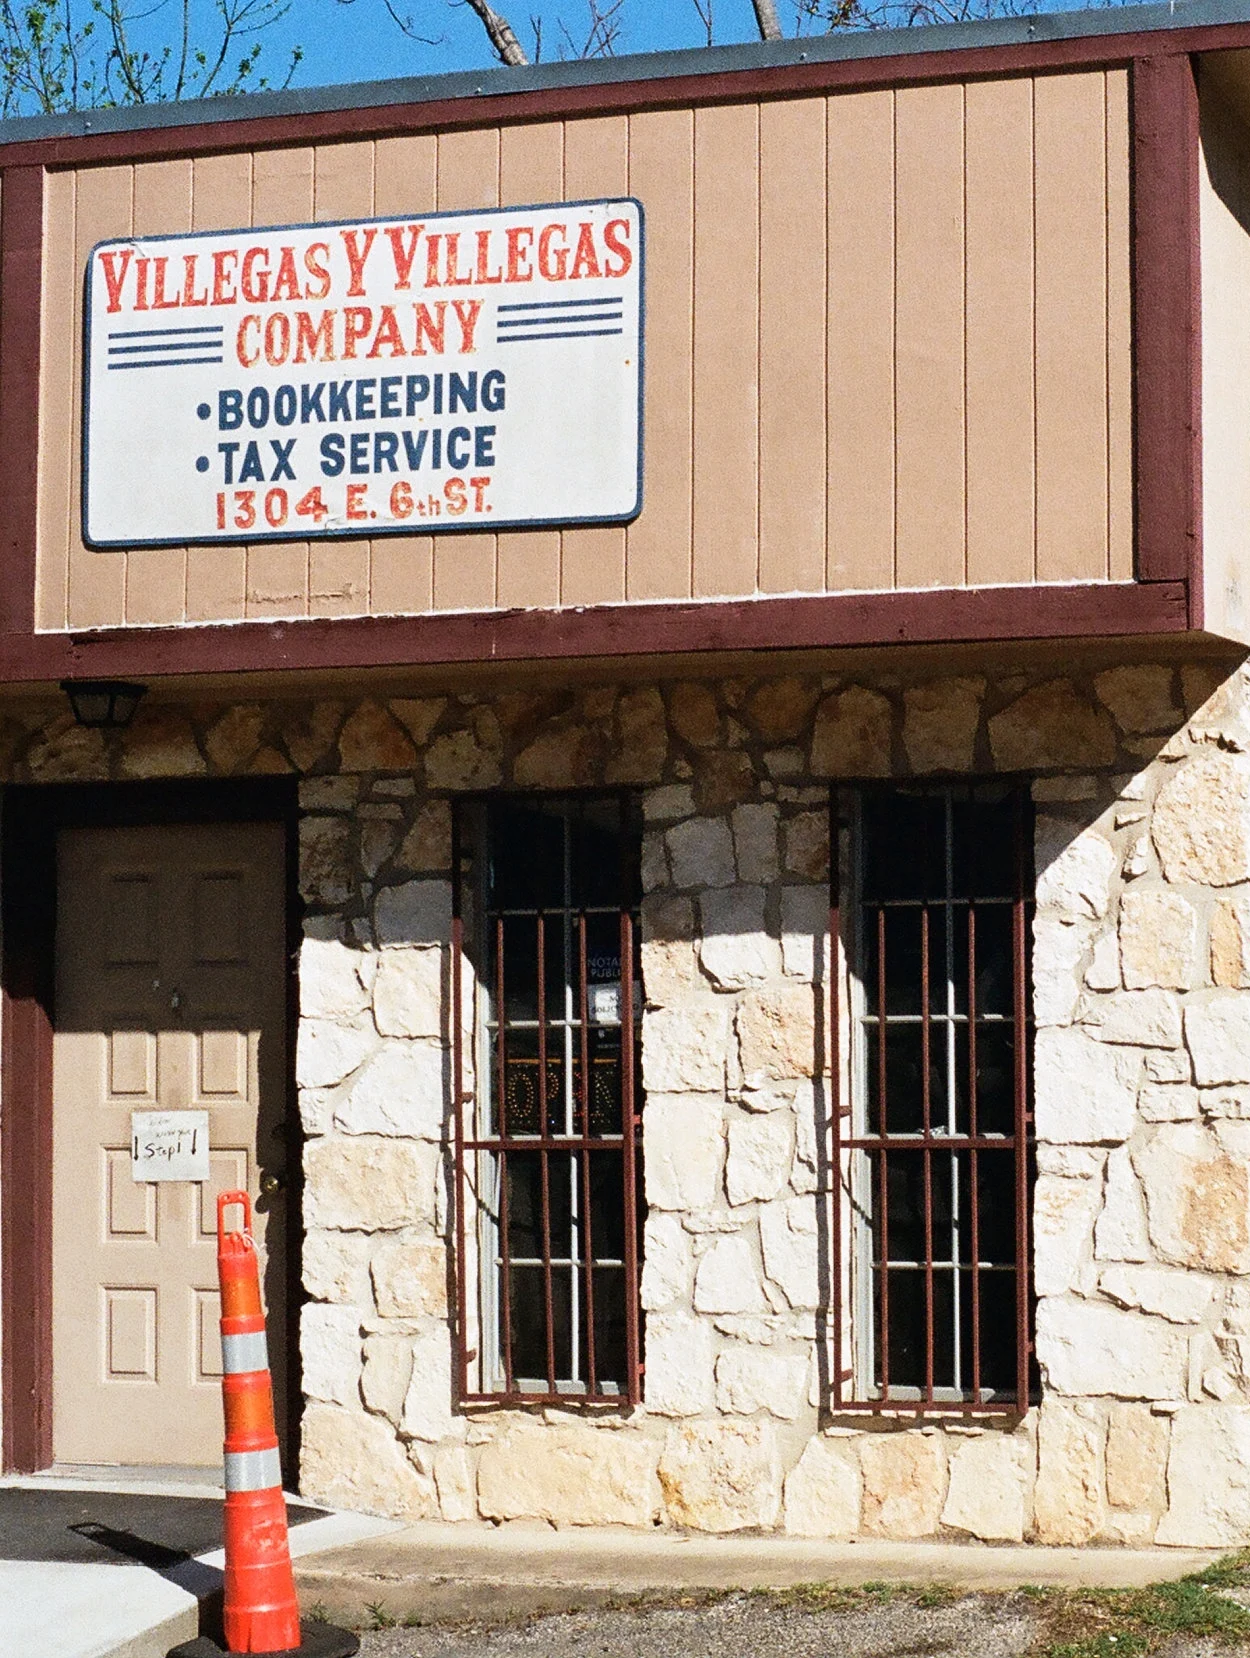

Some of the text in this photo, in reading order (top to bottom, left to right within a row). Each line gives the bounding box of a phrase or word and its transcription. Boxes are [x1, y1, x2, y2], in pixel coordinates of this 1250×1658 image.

[98, 218, 634, 314] VILLEGAS Y VILLEGAS
[235, 298, 485, 369] COMPANY
[217, 369, 507, 431] BOOKKEEPING
[217, 425, 497, 485] TAX SERVICE
[215, 476, 493, 531] 1304 E. 6th ST.
